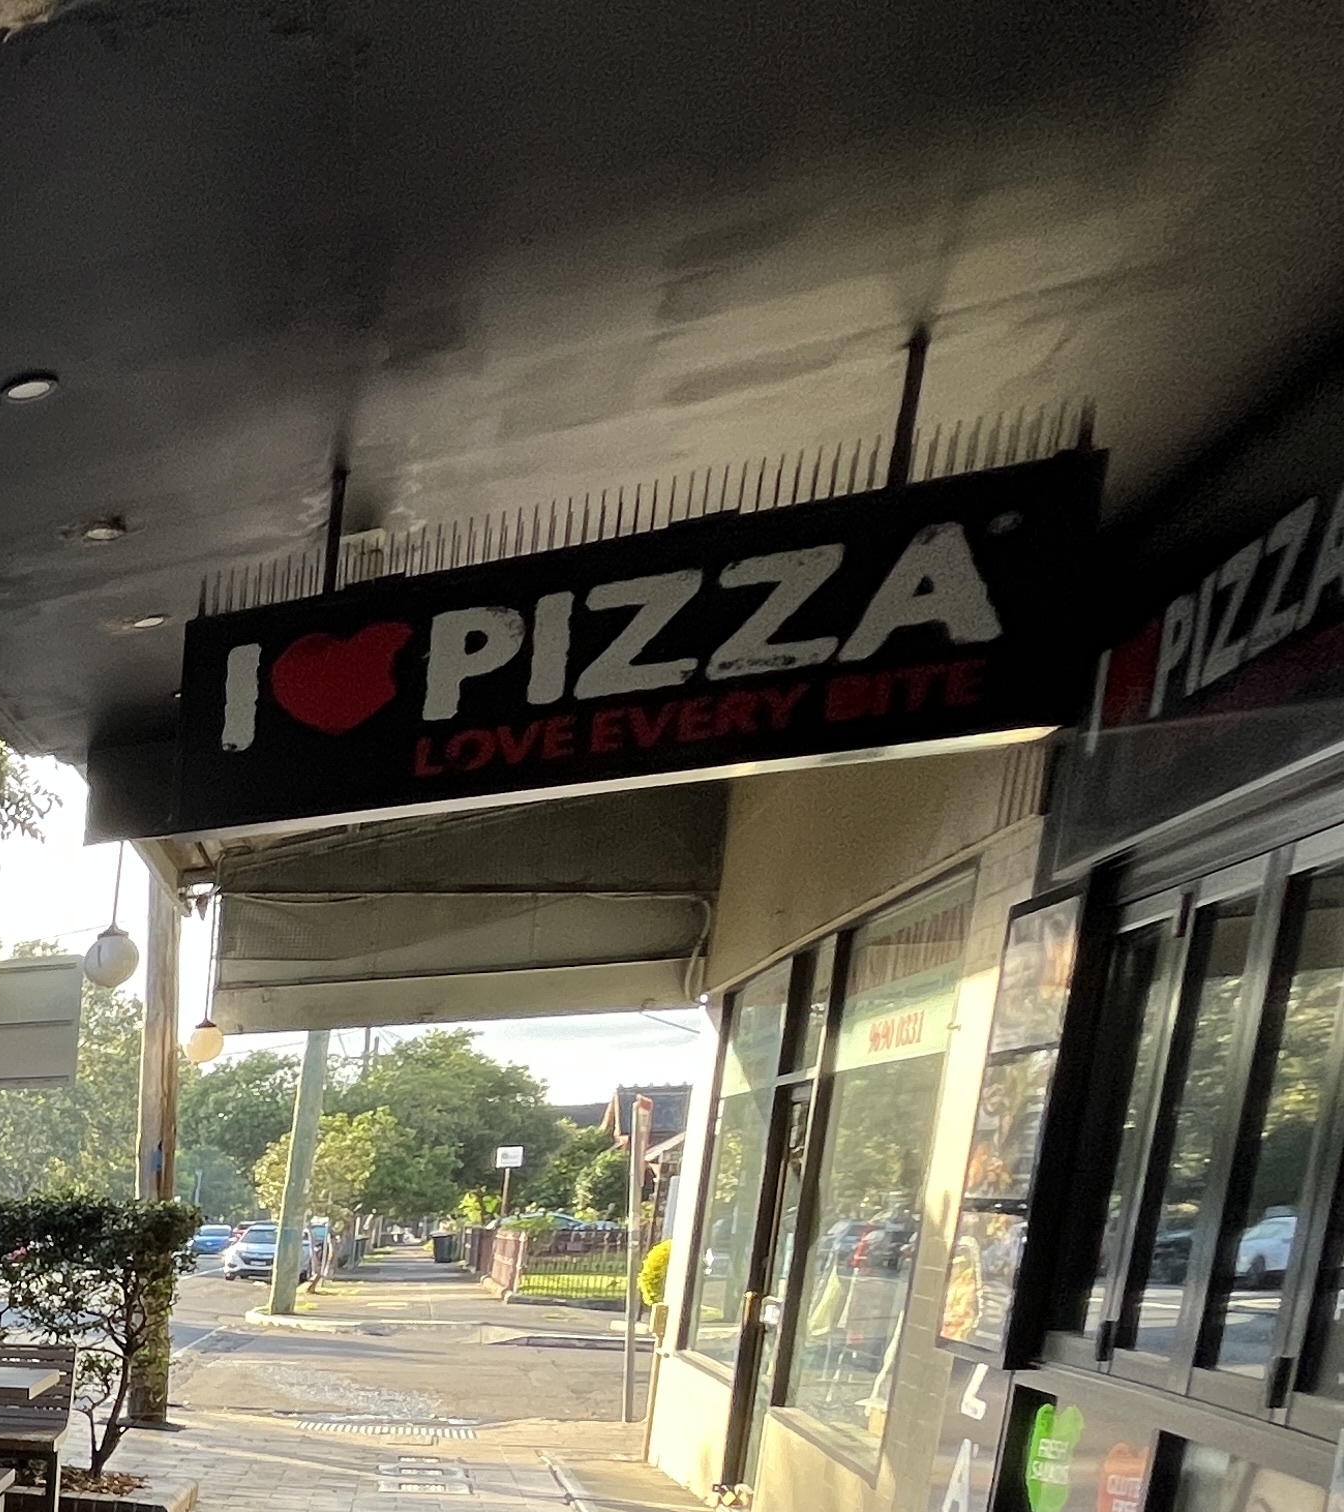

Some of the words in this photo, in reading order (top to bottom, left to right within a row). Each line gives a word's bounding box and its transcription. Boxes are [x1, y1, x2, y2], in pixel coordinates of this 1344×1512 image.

[220, 641, 262, 753] I
[420, 522, 1004, 721] PIZZA
[413, 714, 575, 778] LOVE
[589, 683, 810, 754] EVERY
[824, 658, 988, 723] BITE
